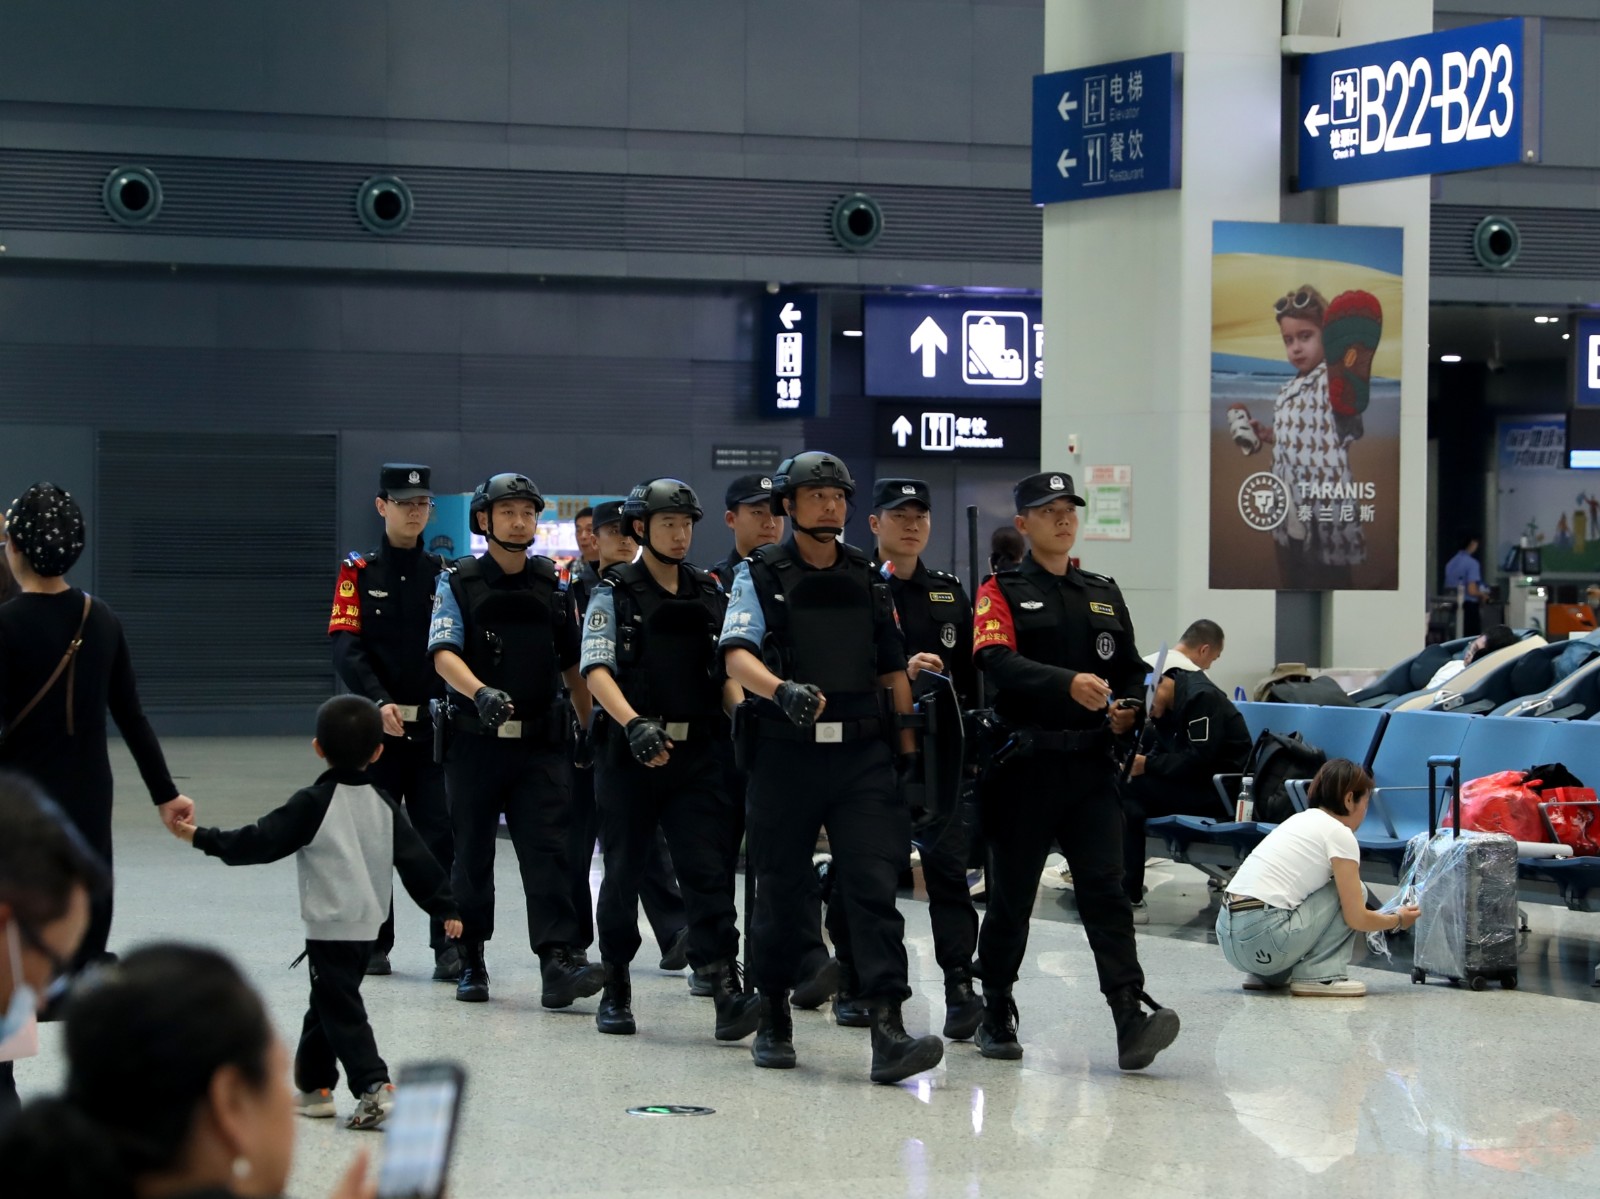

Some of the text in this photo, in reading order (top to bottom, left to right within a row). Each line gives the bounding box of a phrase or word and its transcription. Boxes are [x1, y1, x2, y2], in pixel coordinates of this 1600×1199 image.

[1110, 70, 1143, 103] 电梯
[1360, 43, 1514, 155] B22-B23
[1110, 128, 1144, 161] 餐饮
[1299, 482, 1376, 500] TARANIS
[1298, 504, 1375, 523] 泰兰尼斯
